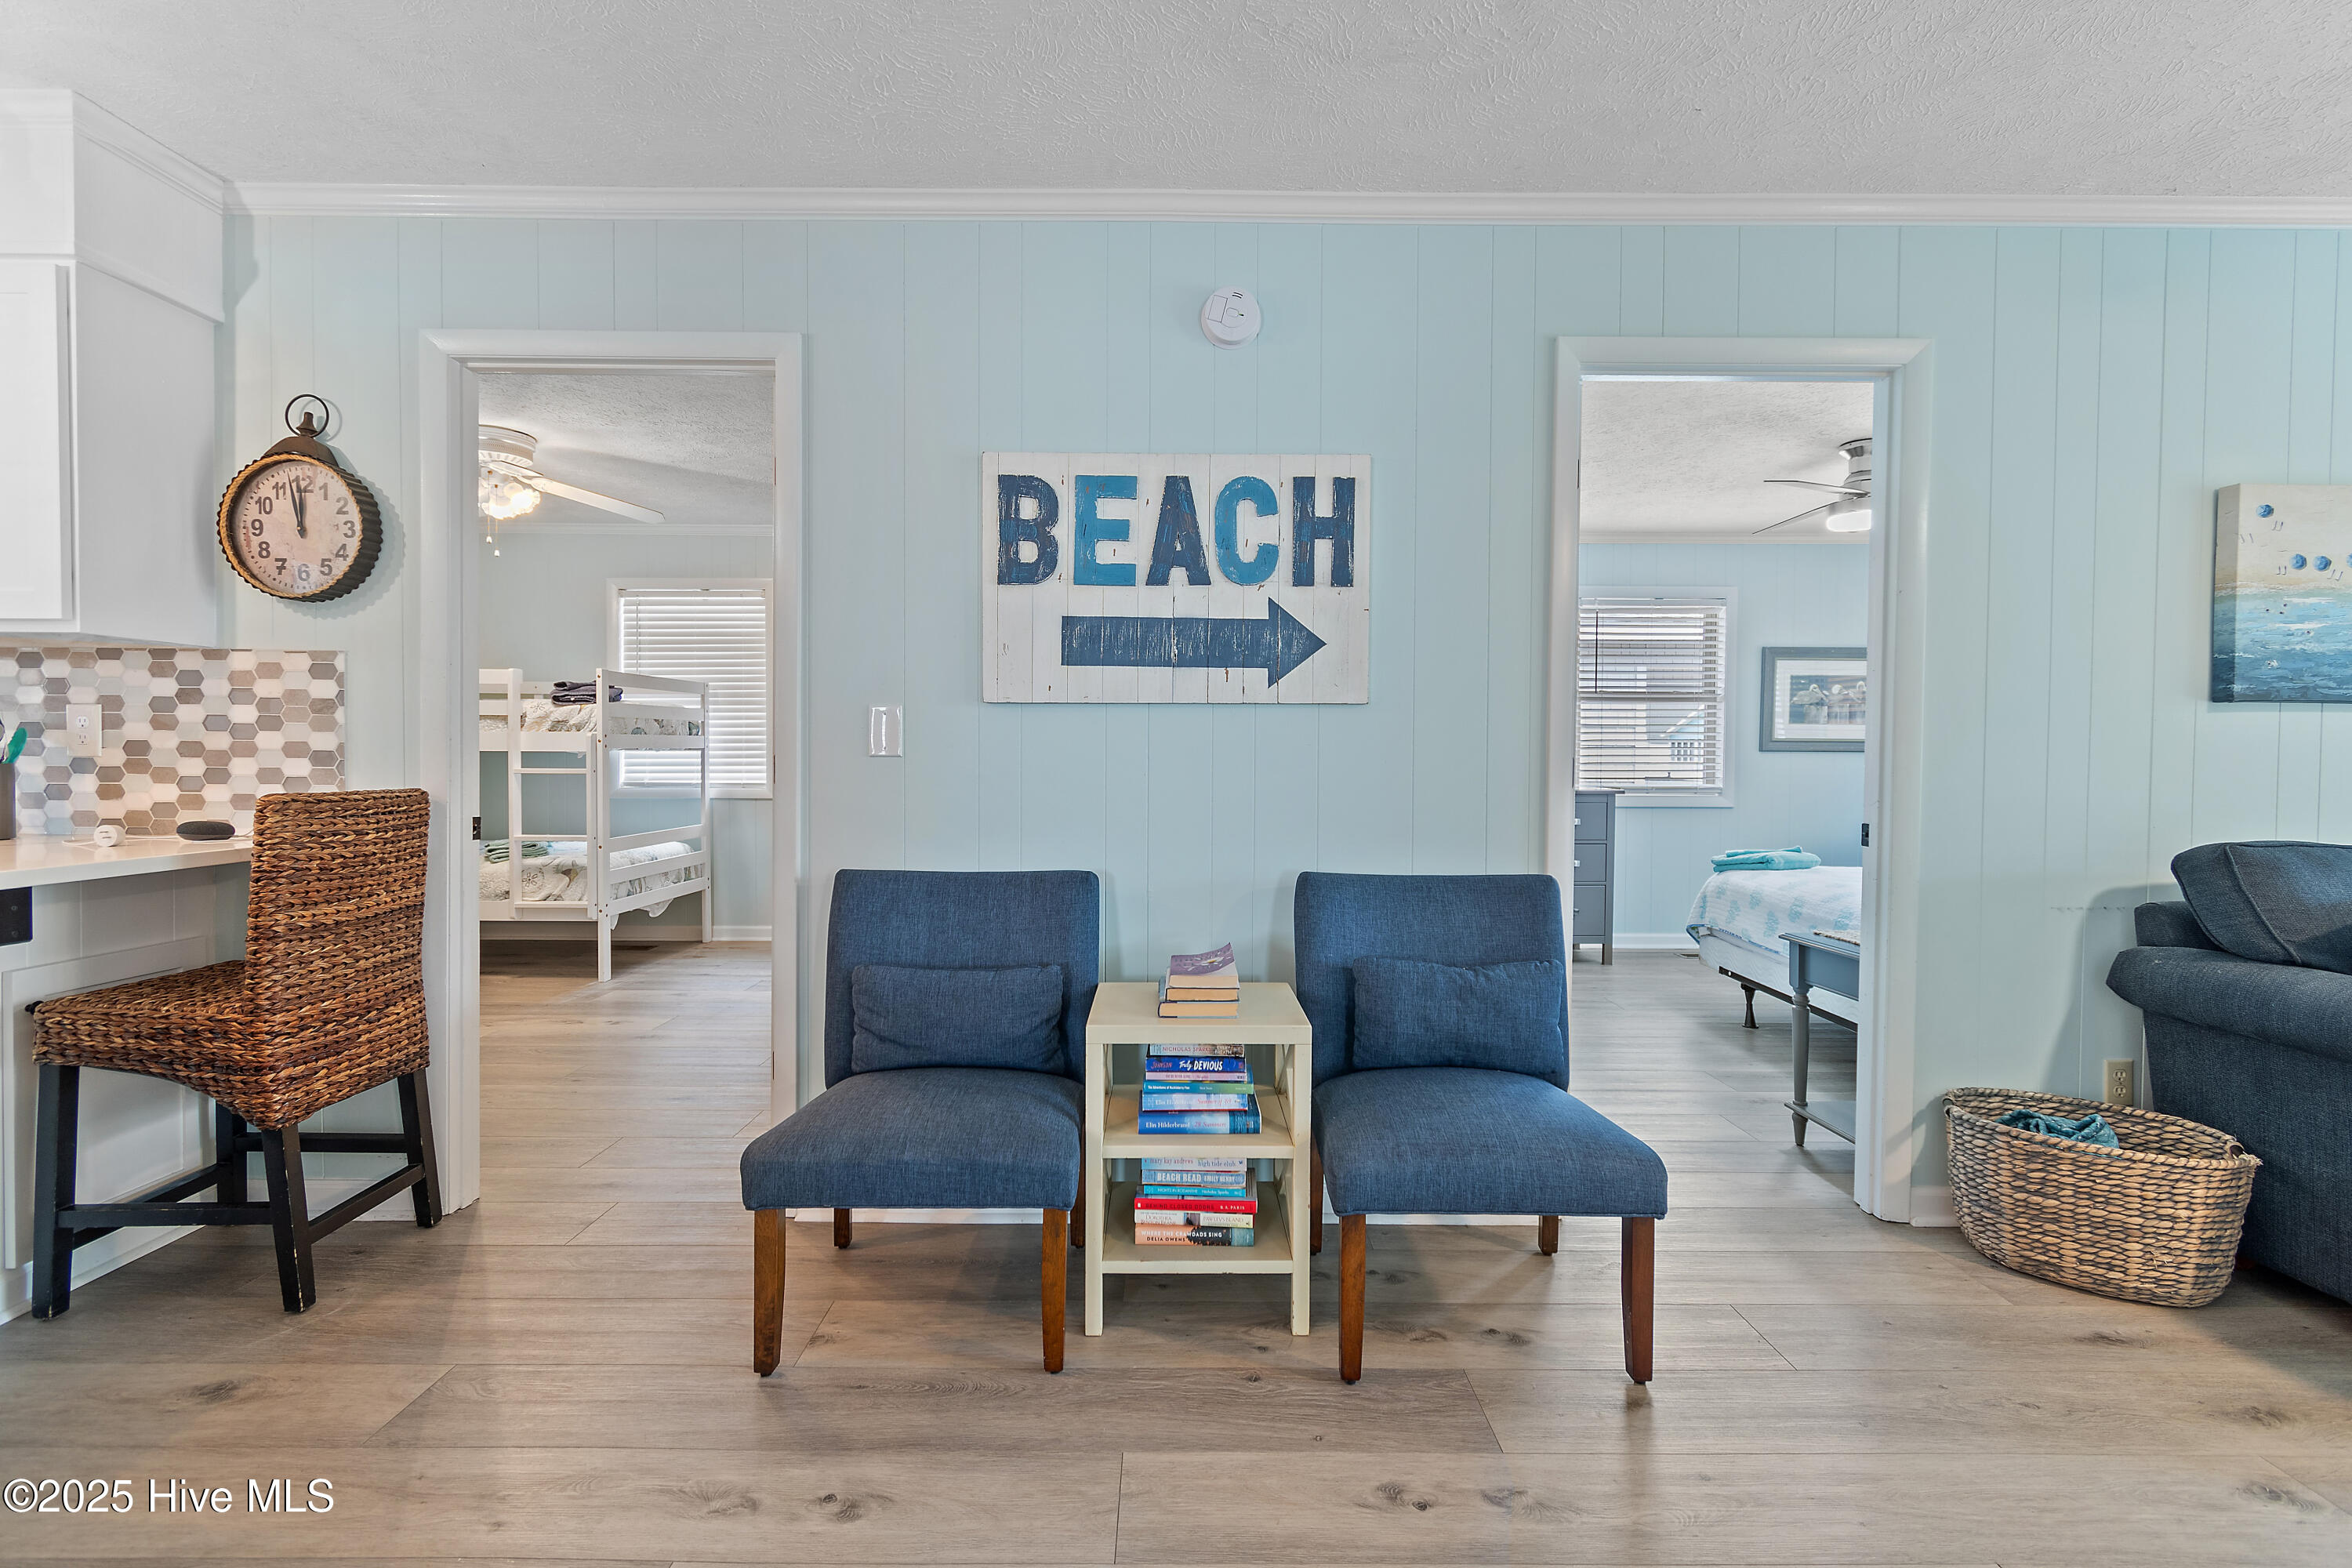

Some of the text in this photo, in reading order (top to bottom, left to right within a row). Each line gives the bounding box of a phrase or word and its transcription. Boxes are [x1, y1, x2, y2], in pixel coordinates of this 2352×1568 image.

[272, 481, 287, 500] 11
[292, 474, 314, 494] 12
[318, 482, 328, 501] 1
[255, 496, 273, 515] 10
[336, 497, 350, 515] 2
[251, 518, 263, 537] 9
[343, 520, 357, 539] 3
[996, 474, 1356, 588] BEACH
[258, 541, 271, 559] 8
[335, 543, 350, 561] 4
[274, 558, 288, 576] 7
[297, 563, 310, 582] 6
[319, 558, 333, 576] 5
[1178, 1060, 1223, 1071] Truly DEVIOUS
[1198, 1159, 1210, 1167] high
[1156, 1172, 1202, 1182] BEACH READ
